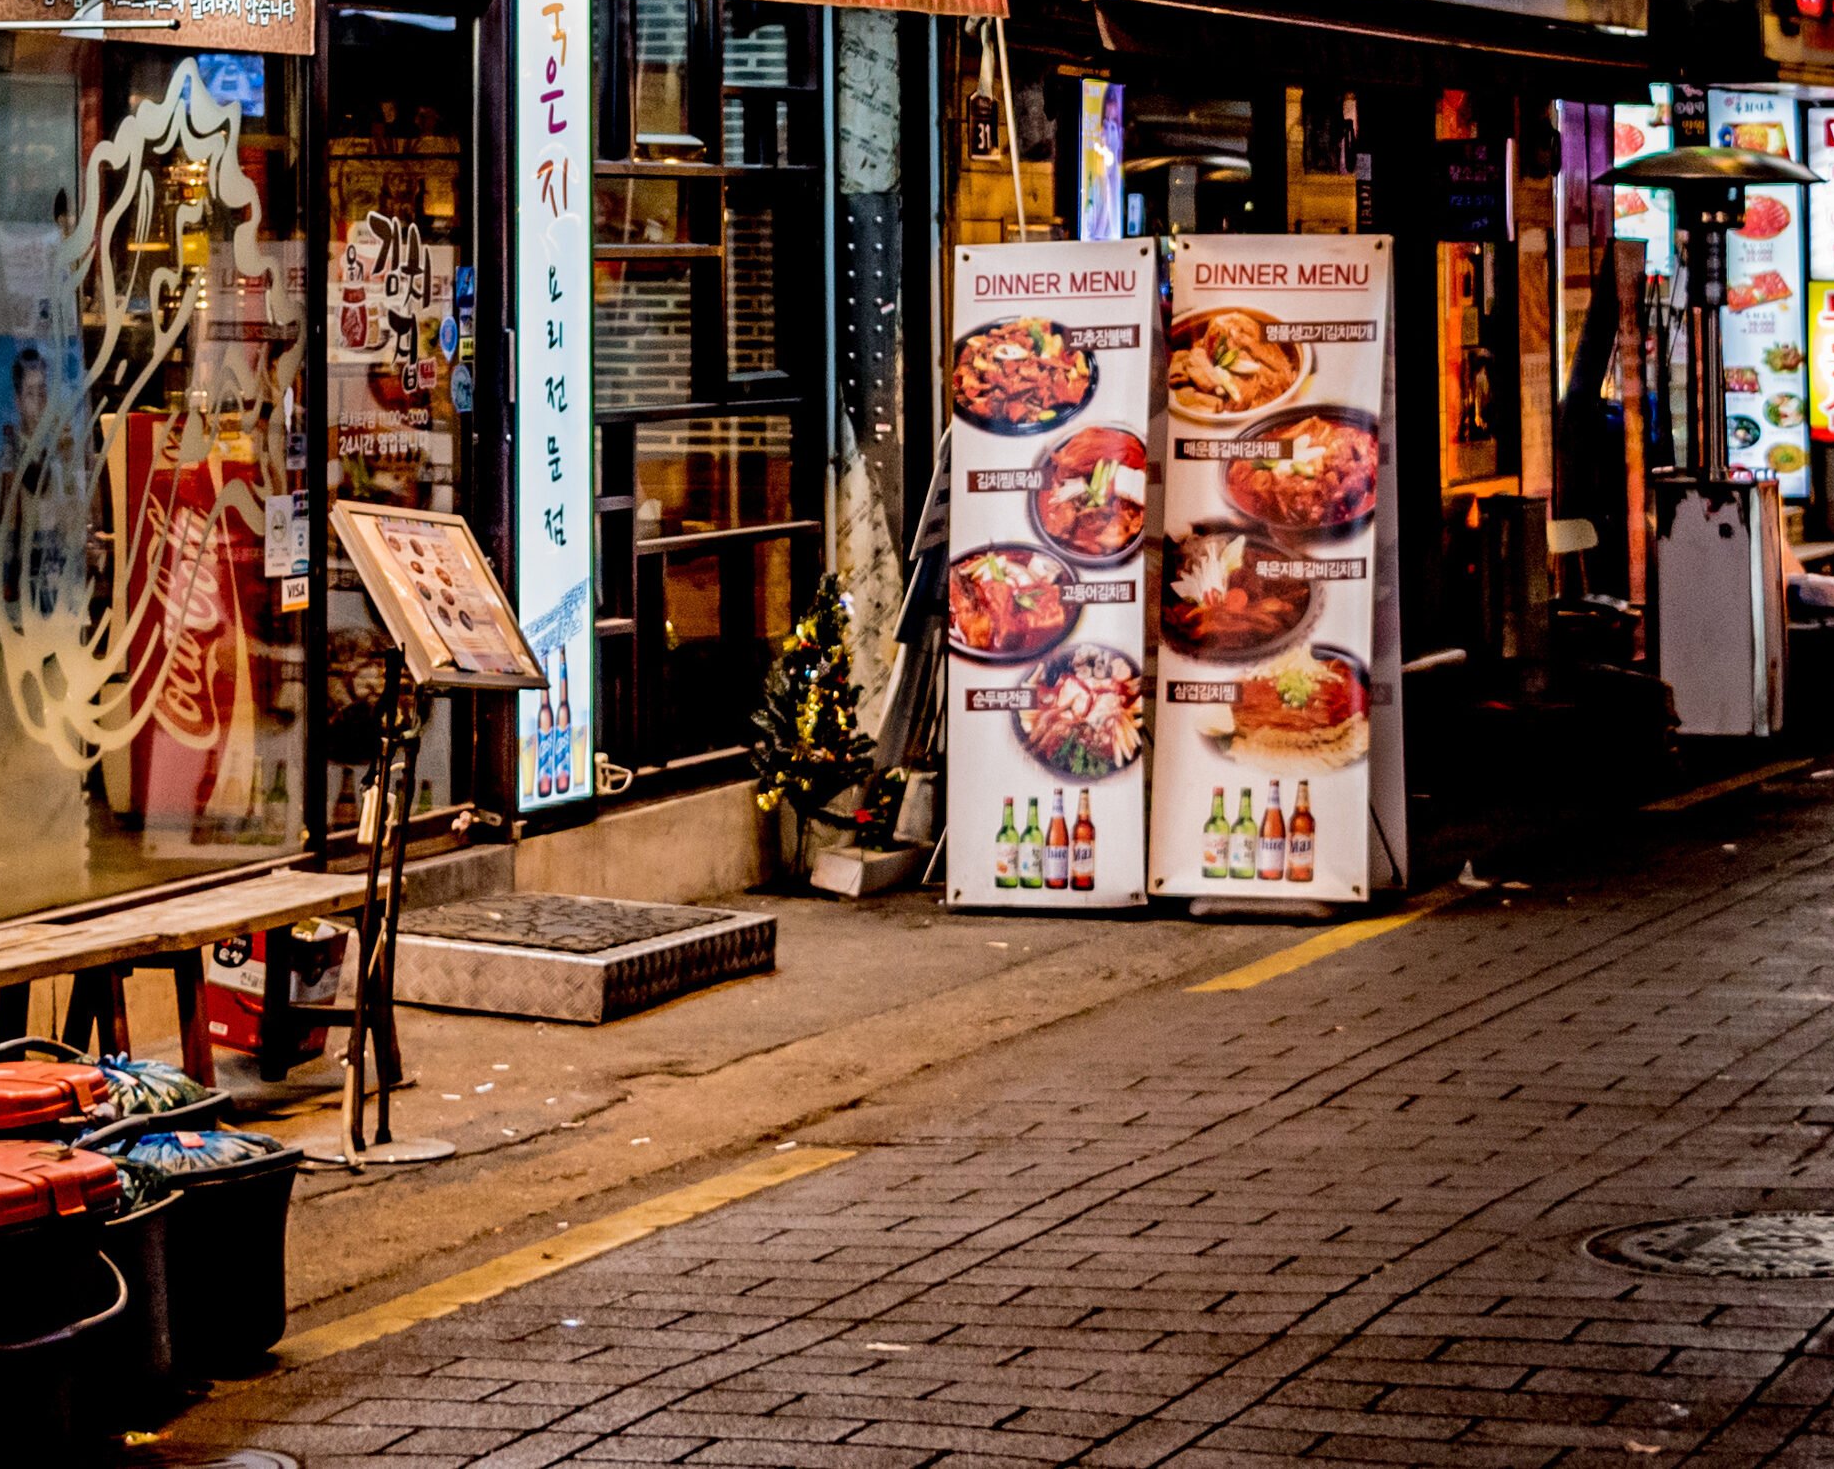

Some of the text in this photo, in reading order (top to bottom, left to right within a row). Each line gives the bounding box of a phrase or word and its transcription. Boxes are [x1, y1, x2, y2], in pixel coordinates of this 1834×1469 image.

[974, 270, 1137, 297] DINNER MENU
[1194, 262, 1369, 287] DINNER MENU
[1069, 327, 1132, 348] 고추장불백
[544, 263, 570, 548] 요리전문점
[338, 434, 373, 456] 24시간
[1183, 440, 1280, 458] 매운통갈비김치찜
[975, 470, 1043, 491] 김치찜(목살)
[287, 583, 306, 599] VISA
[1062, 580, 1131, 602] 고등어김치찜
